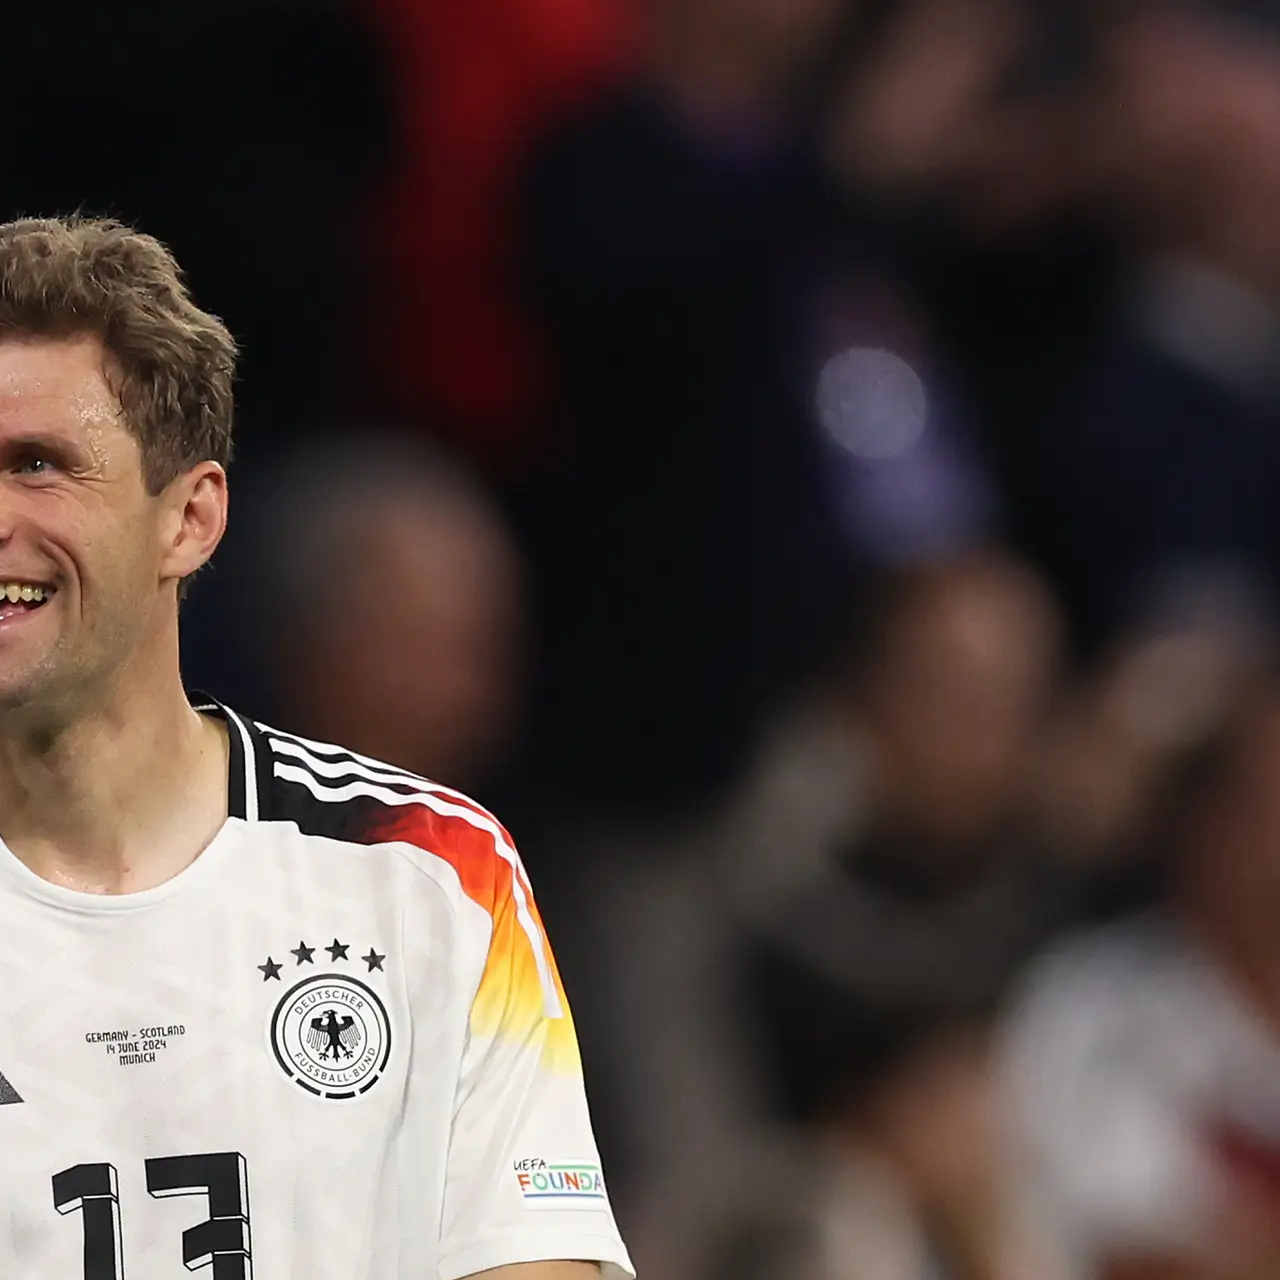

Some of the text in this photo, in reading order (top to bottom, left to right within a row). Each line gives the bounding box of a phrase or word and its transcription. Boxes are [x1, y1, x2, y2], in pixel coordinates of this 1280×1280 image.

[294, 990, 364, 1015] DEUTSCHER
[85, 1030, 129, 1043] GERMANY
[139, 1025, 186, 1039] SCOTLAND
[106, 1039, 167, 1054] 14 JUNE 2024
[119, 1052, 156, 1066] MUNICH
[294, 1047, 376, 1083] FUSSBALL-BUND
[513, 1158, 547, 1171] UEFA
